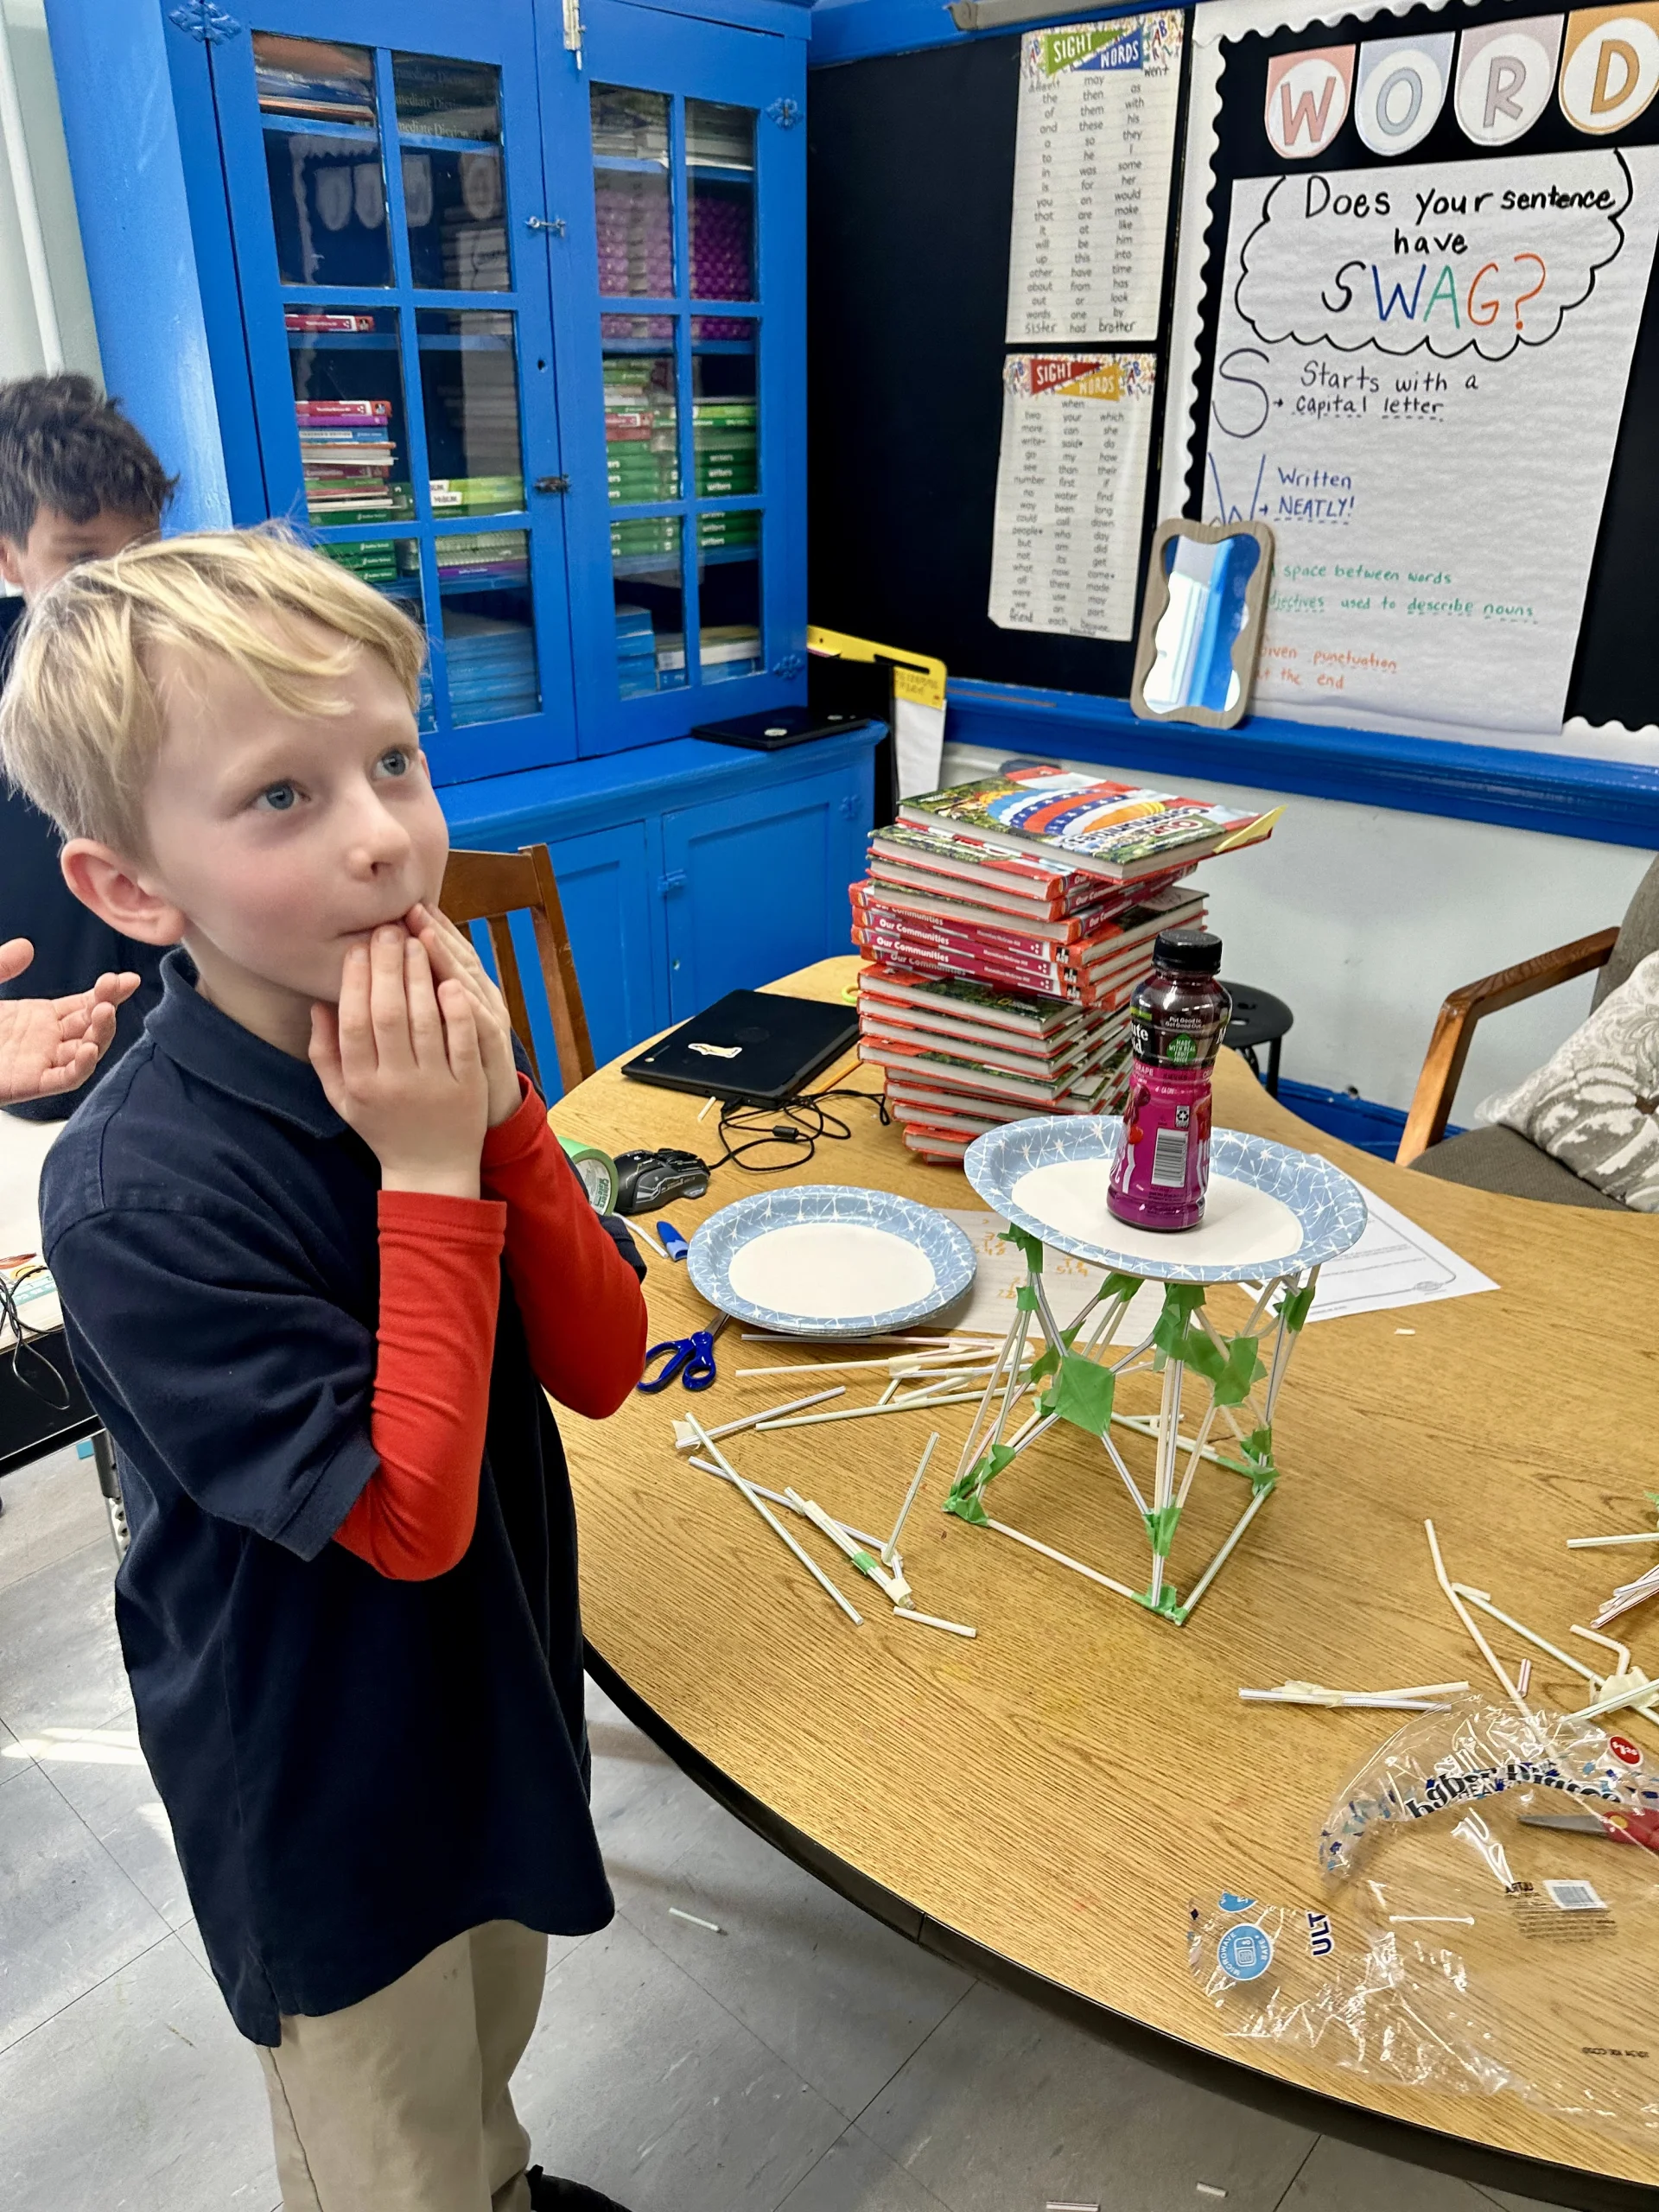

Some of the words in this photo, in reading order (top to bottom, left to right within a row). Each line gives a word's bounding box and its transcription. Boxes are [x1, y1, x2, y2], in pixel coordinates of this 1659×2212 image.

[1053, 33, 1093, 63] SIGHT
[1100, 41, 1140, 68] WORDS
[1042, 91, 1058, 104] the
[1083, 89, 1103, 101] then
[1281, 40, 1639, 146] WORD
[1081, 105, 1104, 116] them
[1125, 98, 1144, 110] with
[1039, 122, 1058, 134] and
[1079, 121, 1103, 131] these
[1127, 113, 1140, 124] his
[1122, 130, 1142, 141] they
[1079, 167, 1096, 175] was
[1118, 160, 1142, 171] some
[1081, 180, 1094, 191] for
[1122, 175, 1136, 186] her
[1037, 199, 1053, 209] you
[1115, 188, 1141, 201] would
[1305, 175, 1391, 219] Does
[1415, 188, 1493, 226] your
[1500, 184, 1616, 212] sentence
[1034, 211, 1054, 222] that
[1115, 205, 1139, 216] make
[1118, 219, 1133, 230] like
[1394, 227, 1468, 254] have
[1321, 252, 1546, 330] SWAG?
[1098, 317, 1137, 334] brother
[1036, 361, 1072, 385] SIGHT
[1300, 359, 1380, 393] Starts
[1395, 371, 1448, 393] with
[1465, 373, 1478, 390] a
[1078, 375, 1115, 396] WORDS
[1211, 347, 1270, 439] S
[1296, 396, 1367, 420] capital
[1383, 396, 1445, 414] letter
[1278, 466, 1351, 490] Written
[1279, 495, 1355, 518] NEATLY!
[1284, 565, 1326, 582] space
[1334, 564, 1399, 581] between
[1408, 571, 1452, 585] words
[1269, 589, 1325, 610] djectives
[1341, 597, 1370, 610] used
[1382, 595, 1395, 610] to
[1408, 596, 1474, 613] describe
[1483, 602, 1534, 617] nouns
[1281, 667, 1300, 686] the
[1317, 672, 1344, 690] end
[1074, 874, 1087, 885] Our
[879, 918, 895, 930] Our
[896, 923, 949, 945] Communities
[876, 937, 893, 948] Our
[894, 941, 949, 963] Communities
[1219, 1931, 1241, 1976] MICROWAVE
